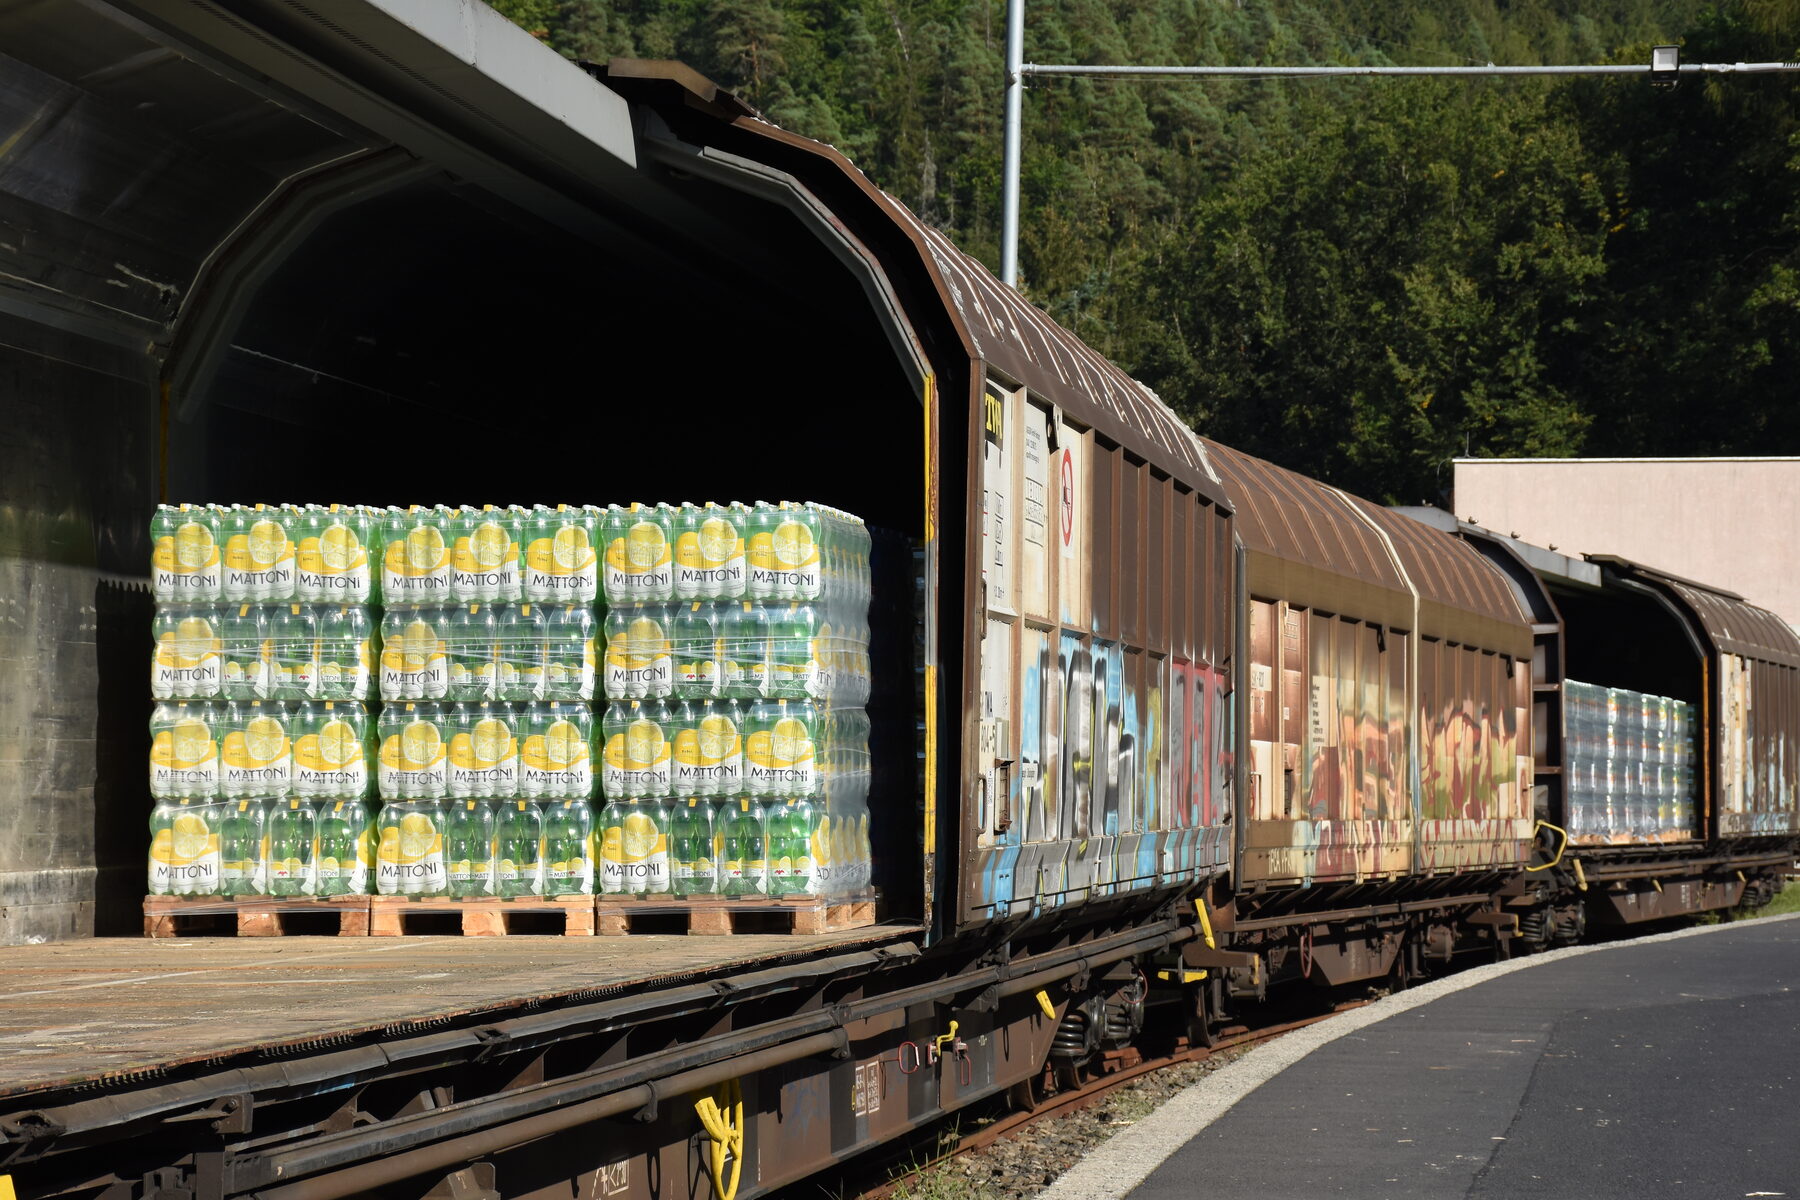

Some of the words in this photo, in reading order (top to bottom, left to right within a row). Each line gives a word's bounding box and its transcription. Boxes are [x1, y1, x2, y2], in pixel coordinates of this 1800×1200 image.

[158, 573, 216, 588] MATTONI
[230, 569, 290, 585] MATTONI
[299, 573, 361, 589] MATTONI
[392, 574, 448, 589] MATTONI
[453, 571, 511, 586] MATTONI
[532, 573, 593, 589] MATTONI
[613, 572, 668, 588] MATTONI
[681, 567, 740, 583] MATTONI
[752, 570, 814, 586] MATTONI
[160, 666, 216, 681] MATTONI
[613, 666, 666, 682] MATTONI
[156, 769, 212, 783] MATTONI
[228, 766, 287, 782] MATTONI
[299, 770, 359, 785] MATTONI
[388, 770, 443, 785] MATTONI
[454, 768, 513, 783] MATTONI
[525, 770, 584, 785] MATTONI
[610, 770, 666, 784] MATTONI
[679, 764, 737, 780] MATTONI
[750, 767, 808, 782] MATTONI
[157, 863, 212, 879] MATTONI
[381, 862, 437, 878] MATTONI
[604, 863, 660, 877] MATTONI
